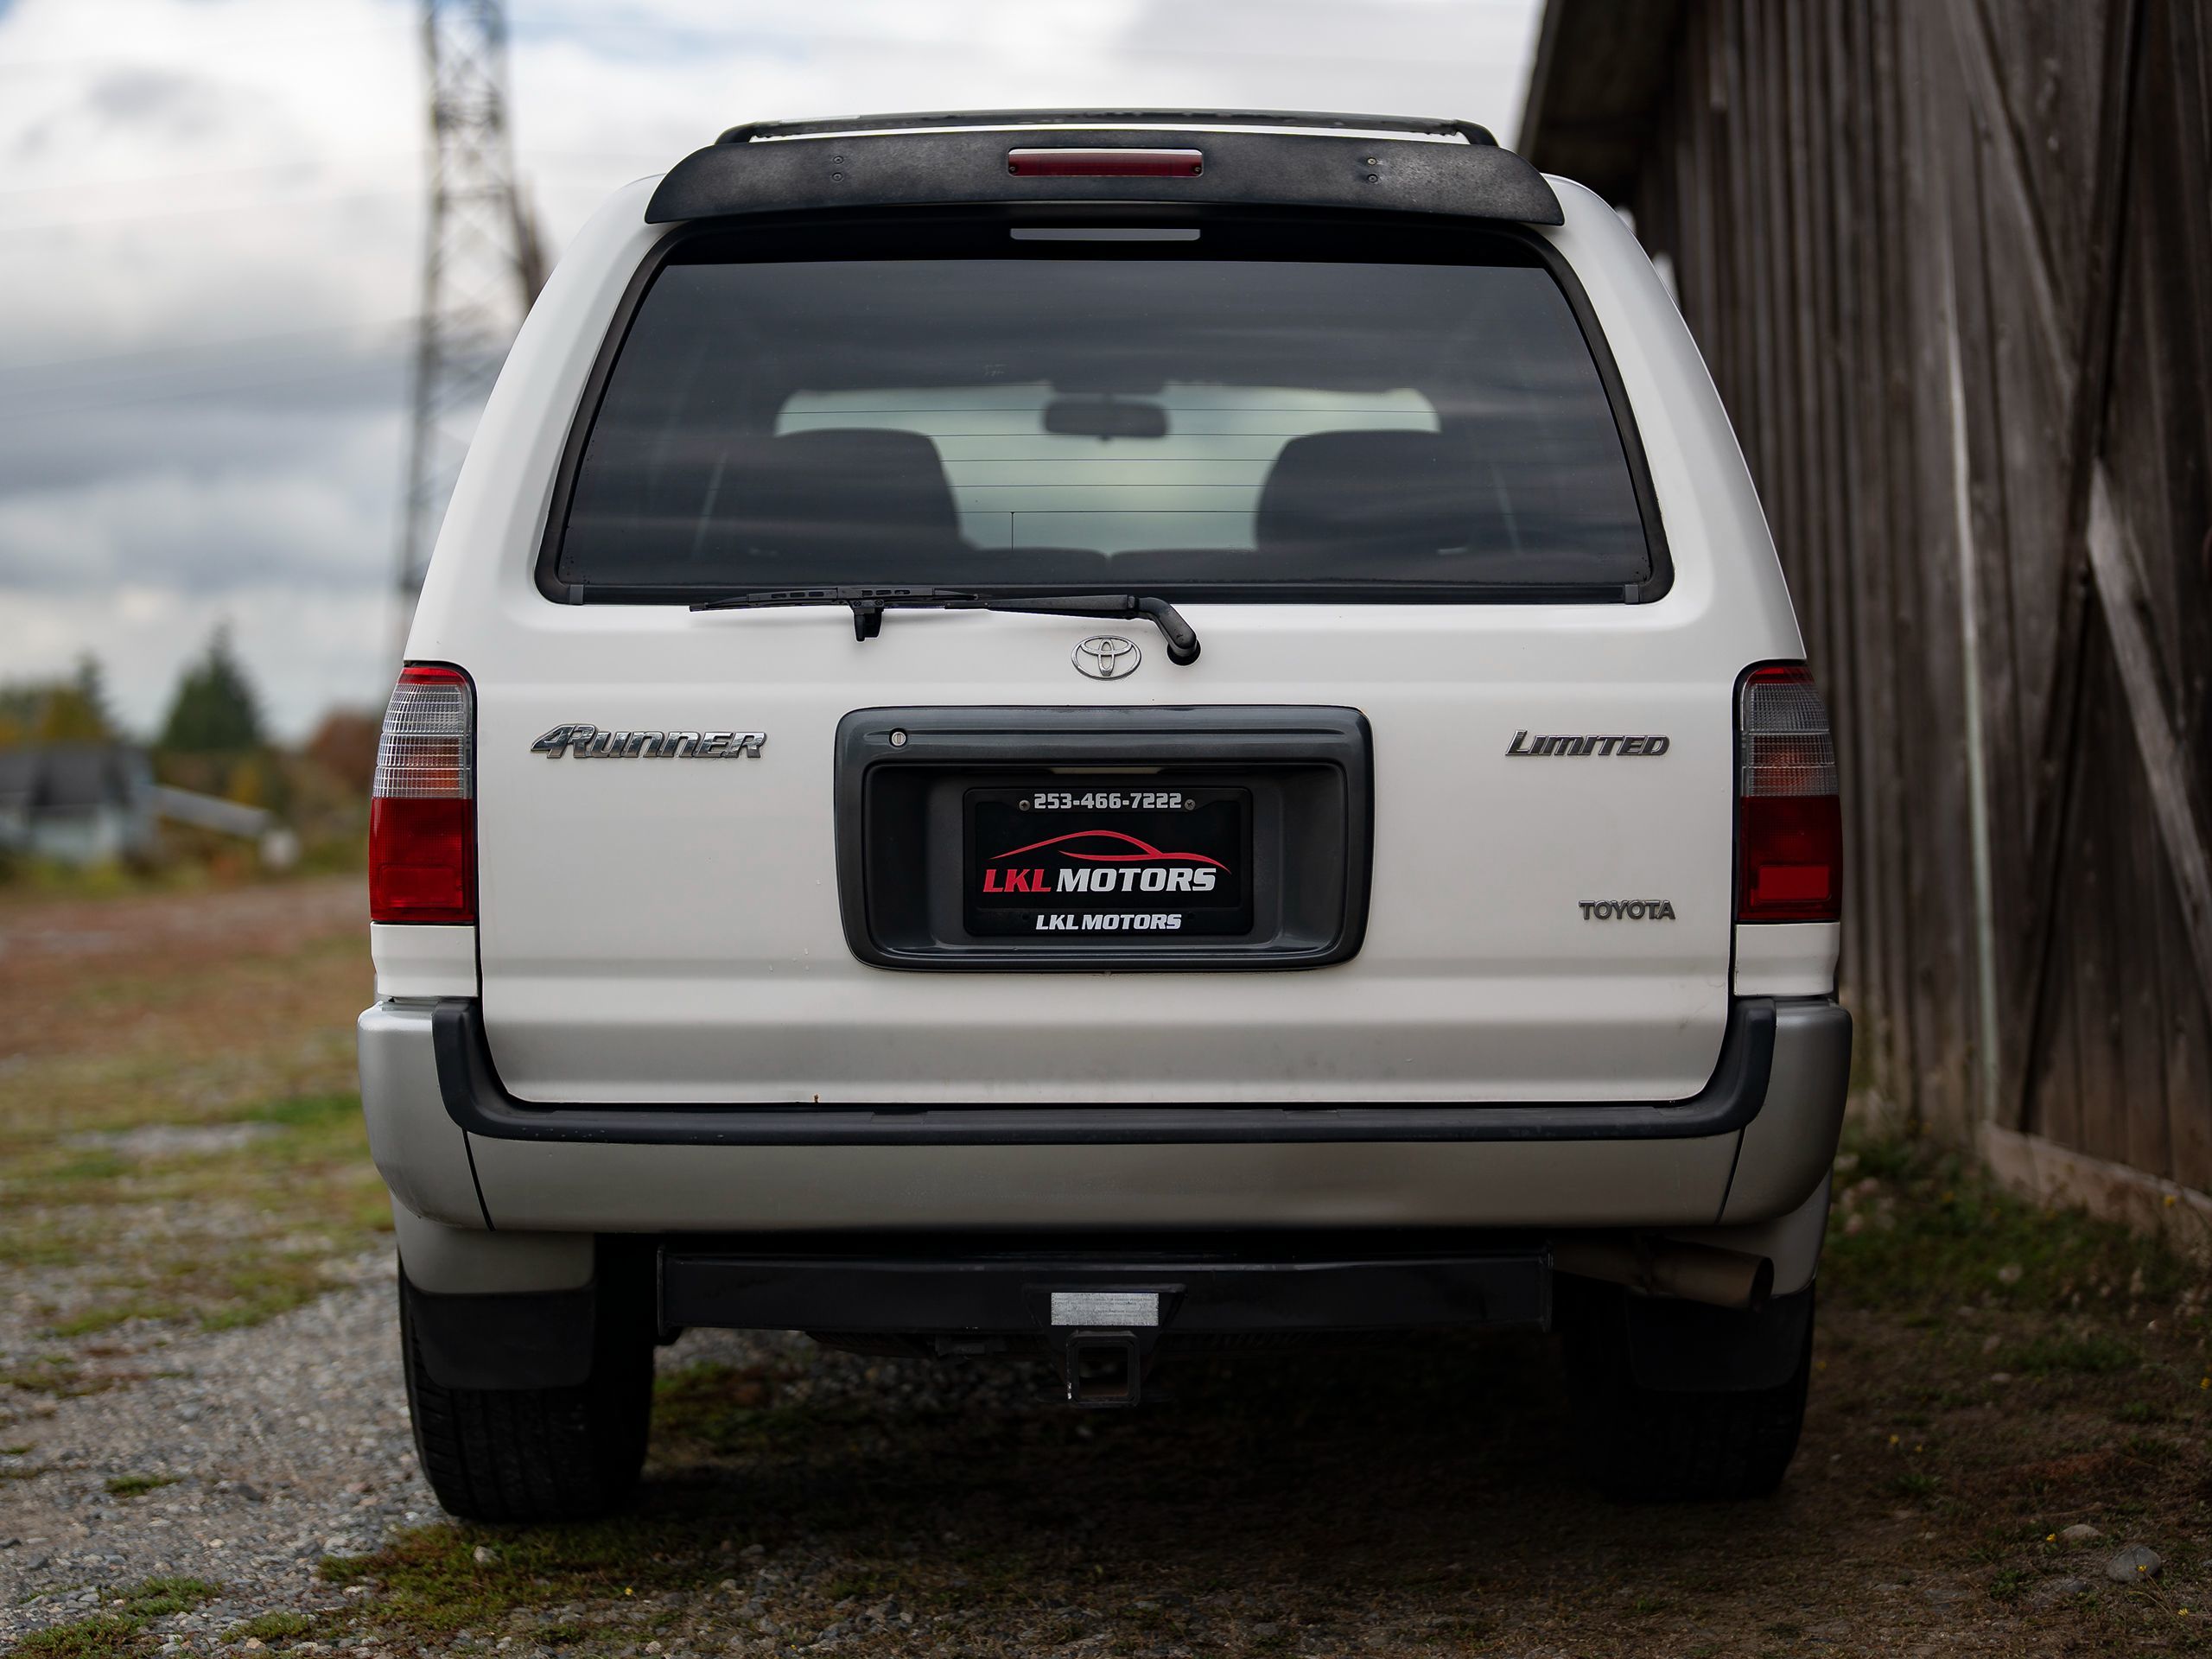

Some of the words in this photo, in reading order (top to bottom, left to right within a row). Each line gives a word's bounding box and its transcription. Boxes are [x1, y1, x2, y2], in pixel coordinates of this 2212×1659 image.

[1034, 793, 1182, 809] 253-466-7222
[983, 868, 1052, 893] LKL
[1057, 868, 1217, 892] MOTORS
[1579, 899, 1676, 920] TOYOTA
[1035, 914, 1079, 931] LKL
[1082, 914, 1182, 930] MOTORS
